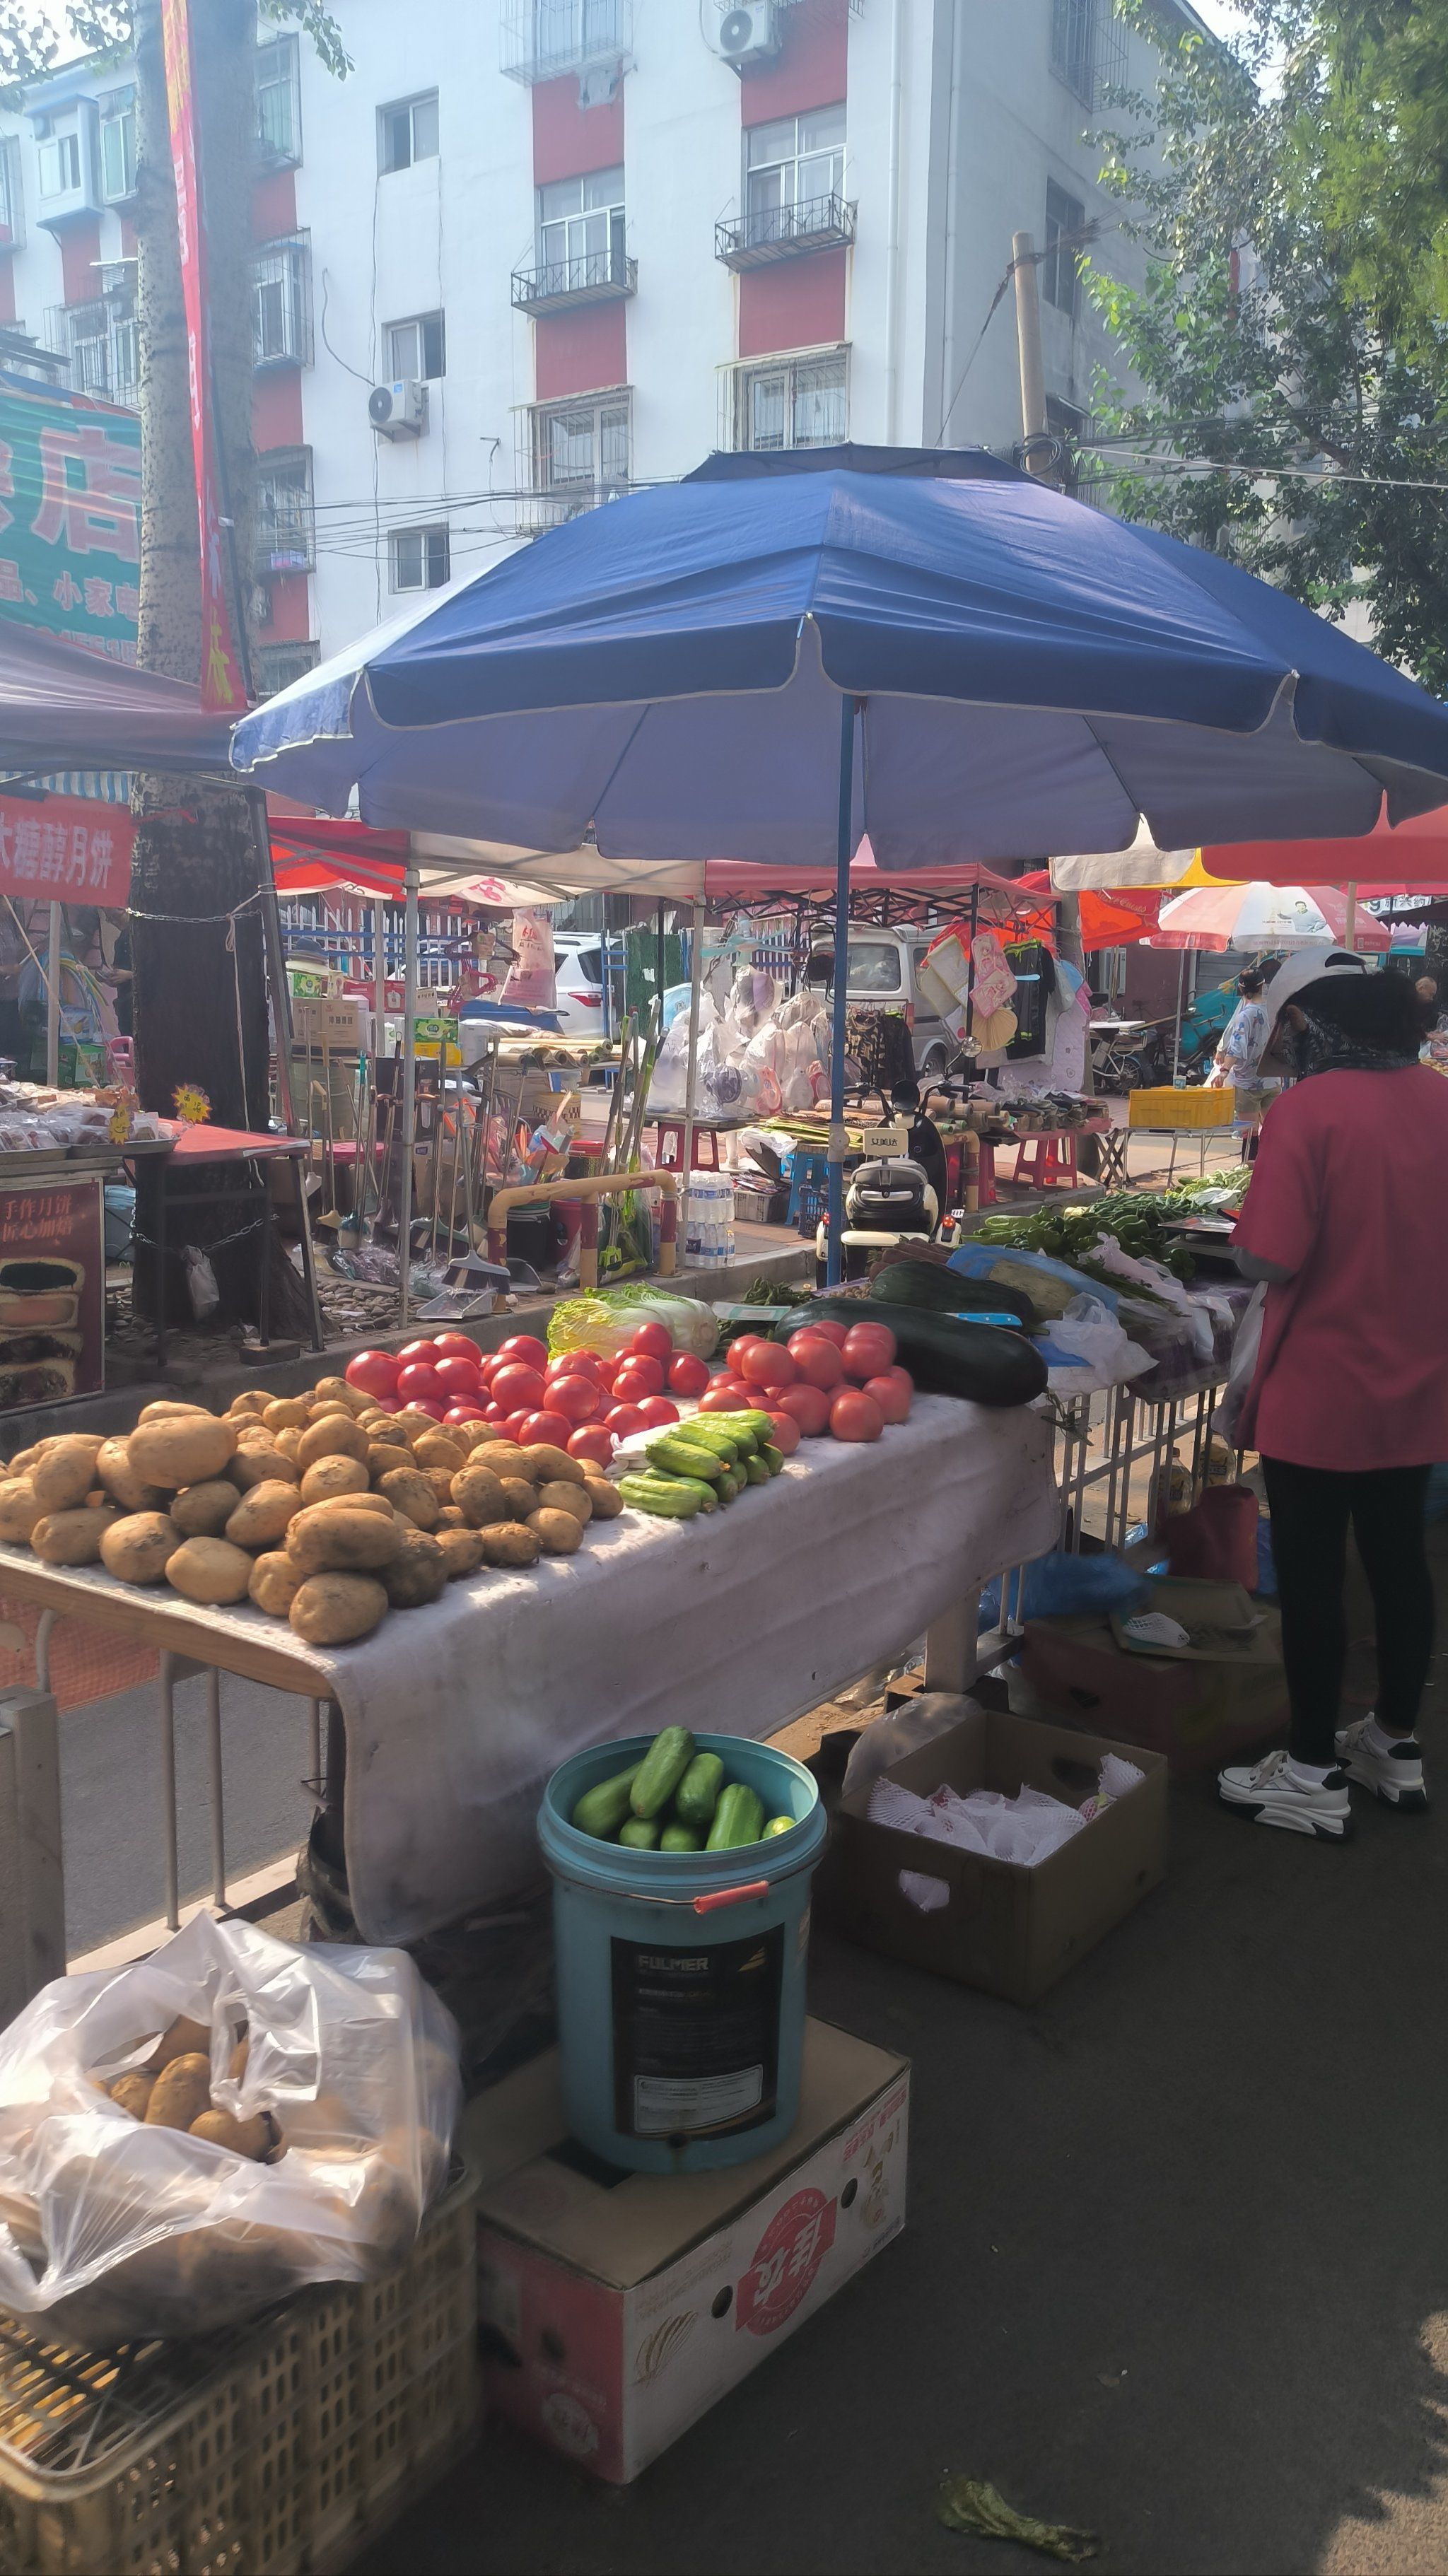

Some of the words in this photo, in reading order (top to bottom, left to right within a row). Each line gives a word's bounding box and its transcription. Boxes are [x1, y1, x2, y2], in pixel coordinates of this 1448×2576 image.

[0, 425, 140, 564] 店
[5, 1194, 71, 1221] 手作月饼
[638, 1954, 709, 1972] FULMER
[753, 2210, 824, 2307] 佳农
